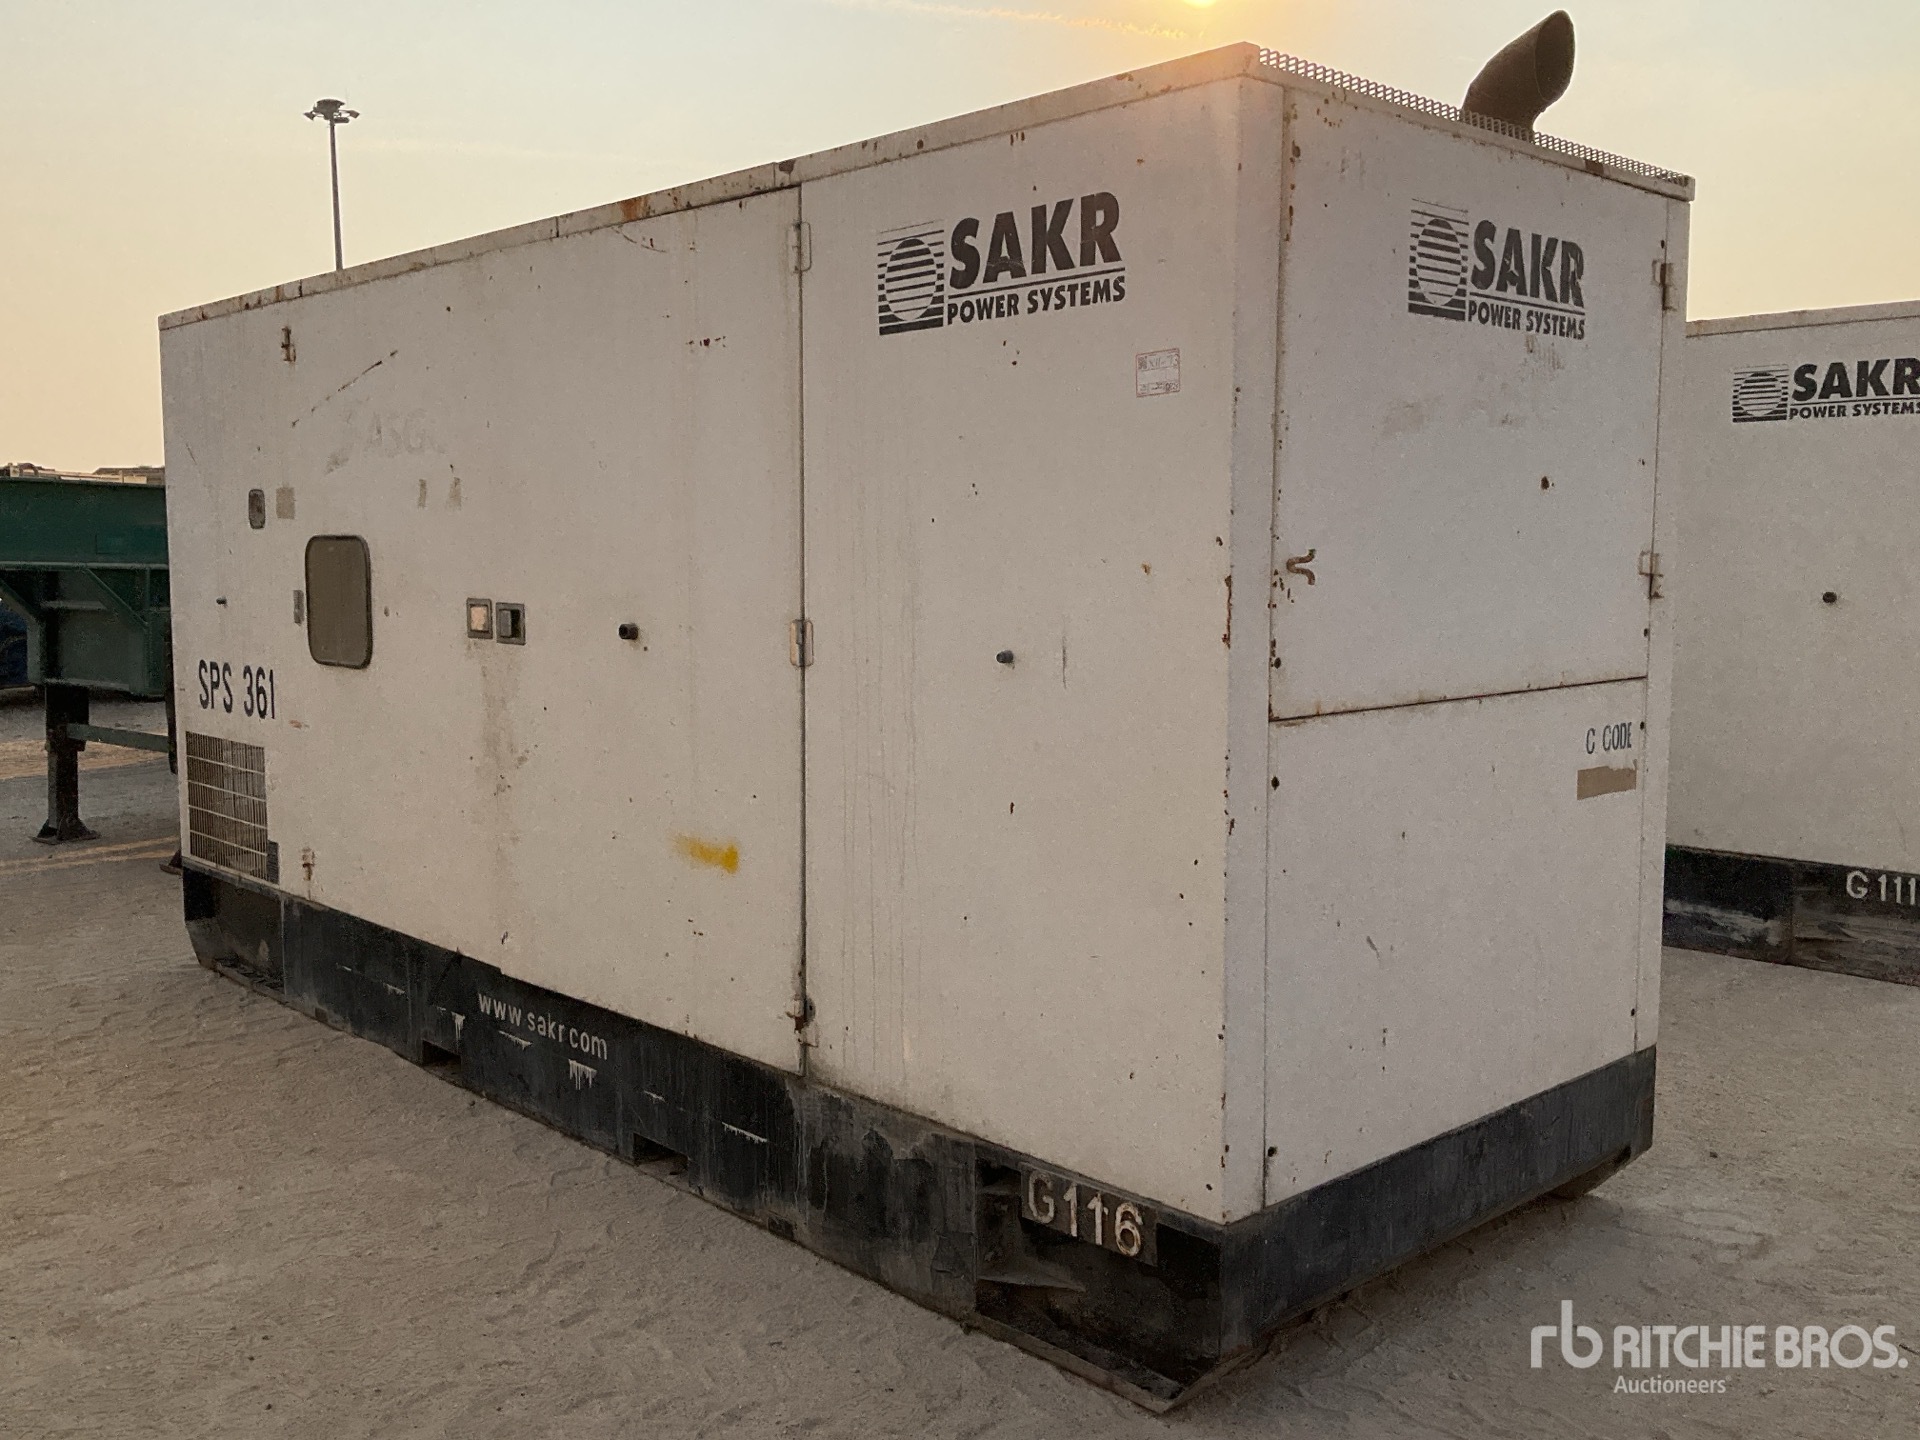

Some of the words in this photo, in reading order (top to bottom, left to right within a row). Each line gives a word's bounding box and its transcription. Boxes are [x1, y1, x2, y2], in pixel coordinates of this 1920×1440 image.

[949, 191, 1122, 289] SAKR
[1470, 220, 1585, 308] SAKR
[947, 292, 1020, 325] POWER
[1026, 274, 1126, 314] SYSTEMS
[1468, 301, 1521, 331] POWER
[1526, 309, 1585, 340] SYSTEMS
[1792, 357, 1920, 400] SAKR
[1789, 404, 1847, 420] POWER
[198, 659, 233, 713] SPS
[242, 665, 275, 720] 361
[1586, 727, 1596, 755] C
[1602, 721, 1632, 752] CODE
[1846, 870, 1916, 906] G111
[1028, 1171, 1143, 1257] G116
